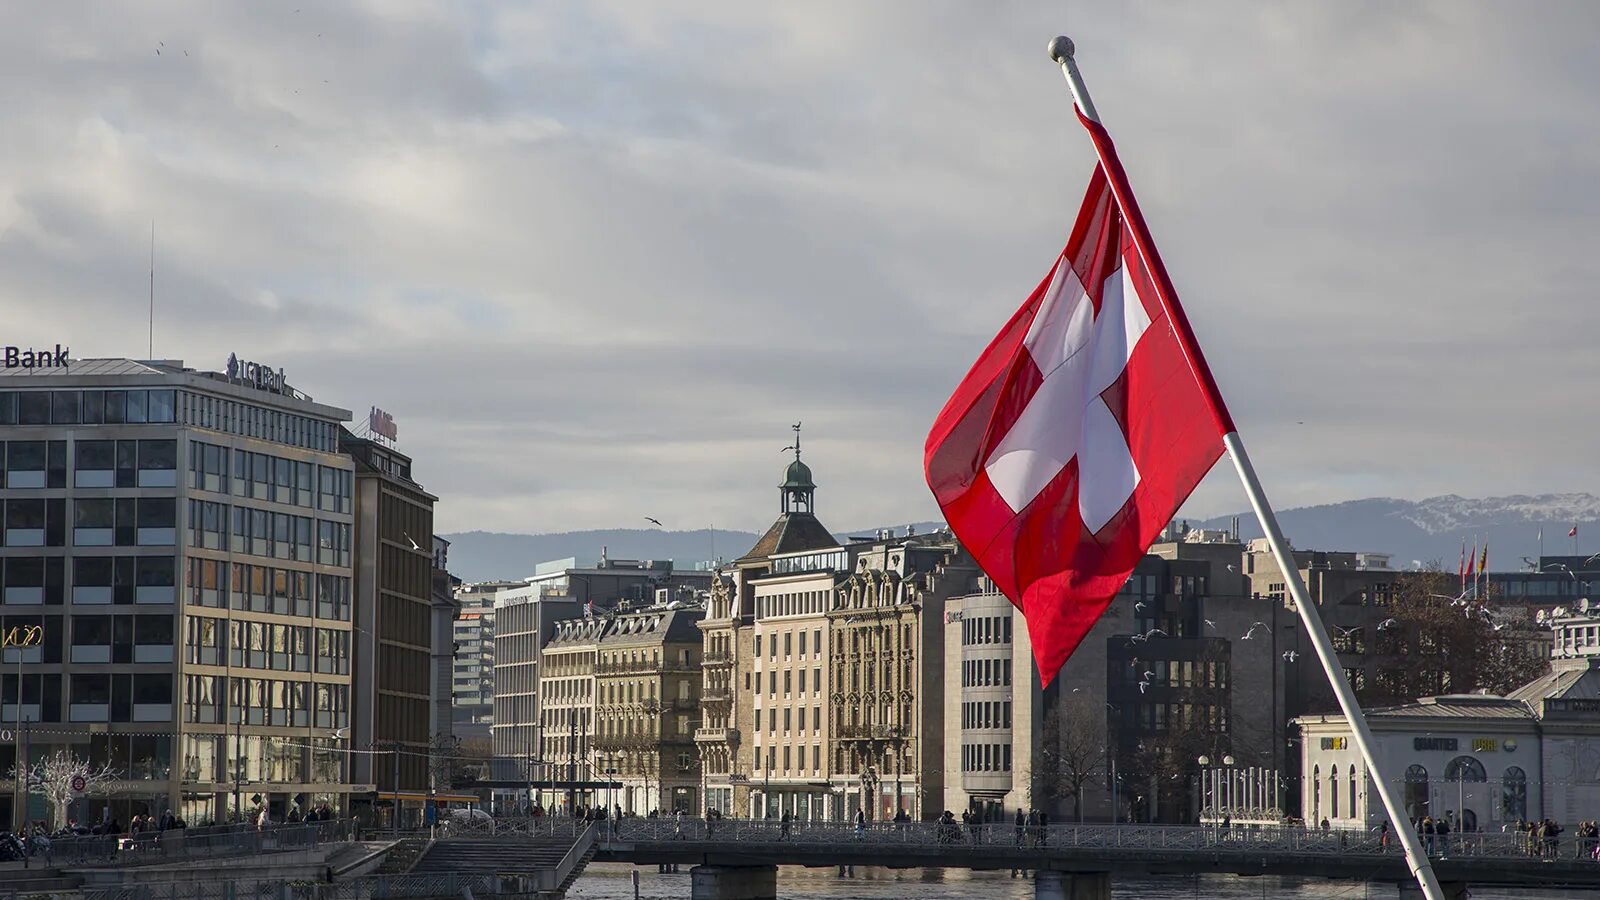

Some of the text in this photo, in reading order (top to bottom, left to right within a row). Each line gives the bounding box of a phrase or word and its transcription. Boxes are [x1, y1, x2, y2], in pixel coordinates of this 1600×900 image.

[5, 344, 69, 368] Bank
[261, 365, 286, 391] Bank
[0, 729, 13, 741] O.
